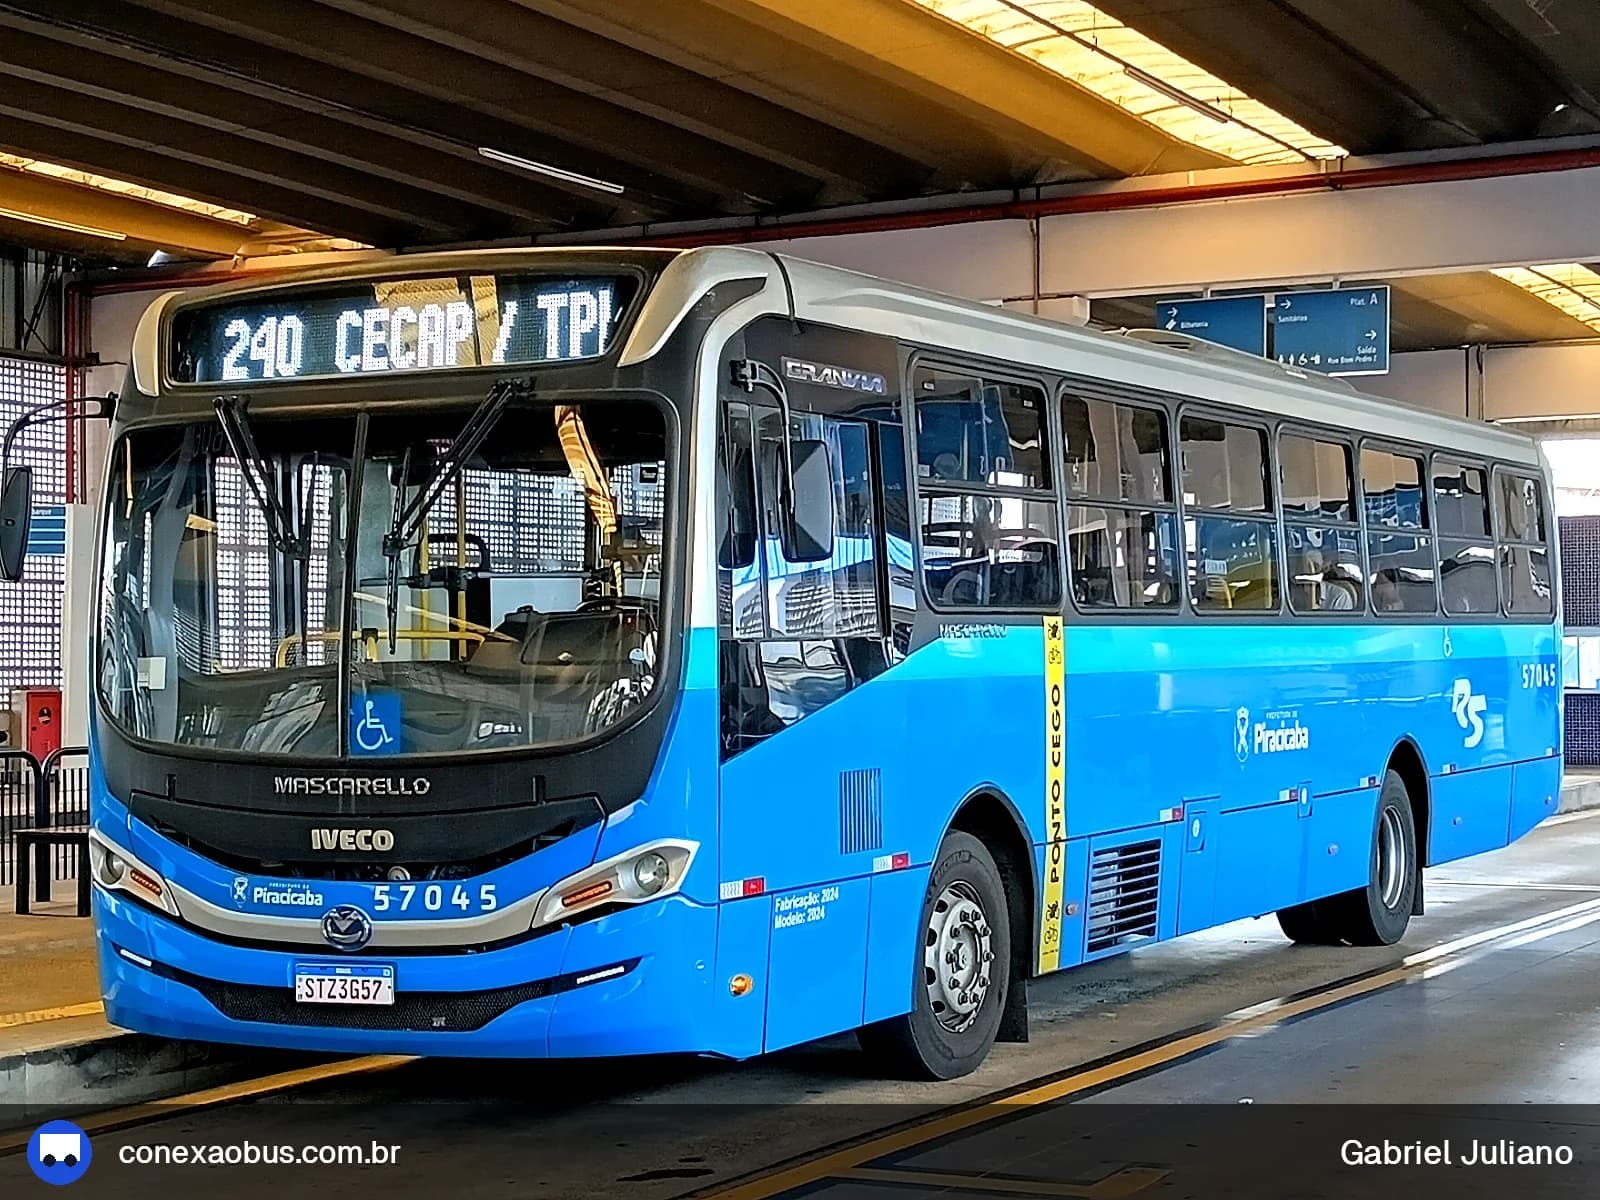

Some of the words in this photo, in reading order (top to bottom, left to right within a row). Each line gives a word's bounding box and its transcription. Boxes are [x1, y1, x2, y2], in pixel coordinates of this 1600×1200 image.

[1369, 292, 1378, 305] A
[222, 314, 303, 380] 240
[335, 301, 474, 373] CECAP
[493, 300, 517, 364] /
[1522, 663, 1556, 689] 57045
[1051, 683, 1062, 768] CEGO
[1254, 719, 1309, 754] Piracicaba
[274, 776, 431, 796] MASCARELLO
[311, 828, 395, 851] IVECO
[1050, 779, 1062, 883] PONTO
[253, 886, 323, 906] Piracicaba
[373, 884, 497, 911] 57045
[775, 892, 820, 912] Fabricação:
[820, 886, 839, 903] 2024
[774, 911, 806, 929] Modelo:
[806, 904, 825, 922] 2024
[305, 977, 383, 1001] STZ3G57
